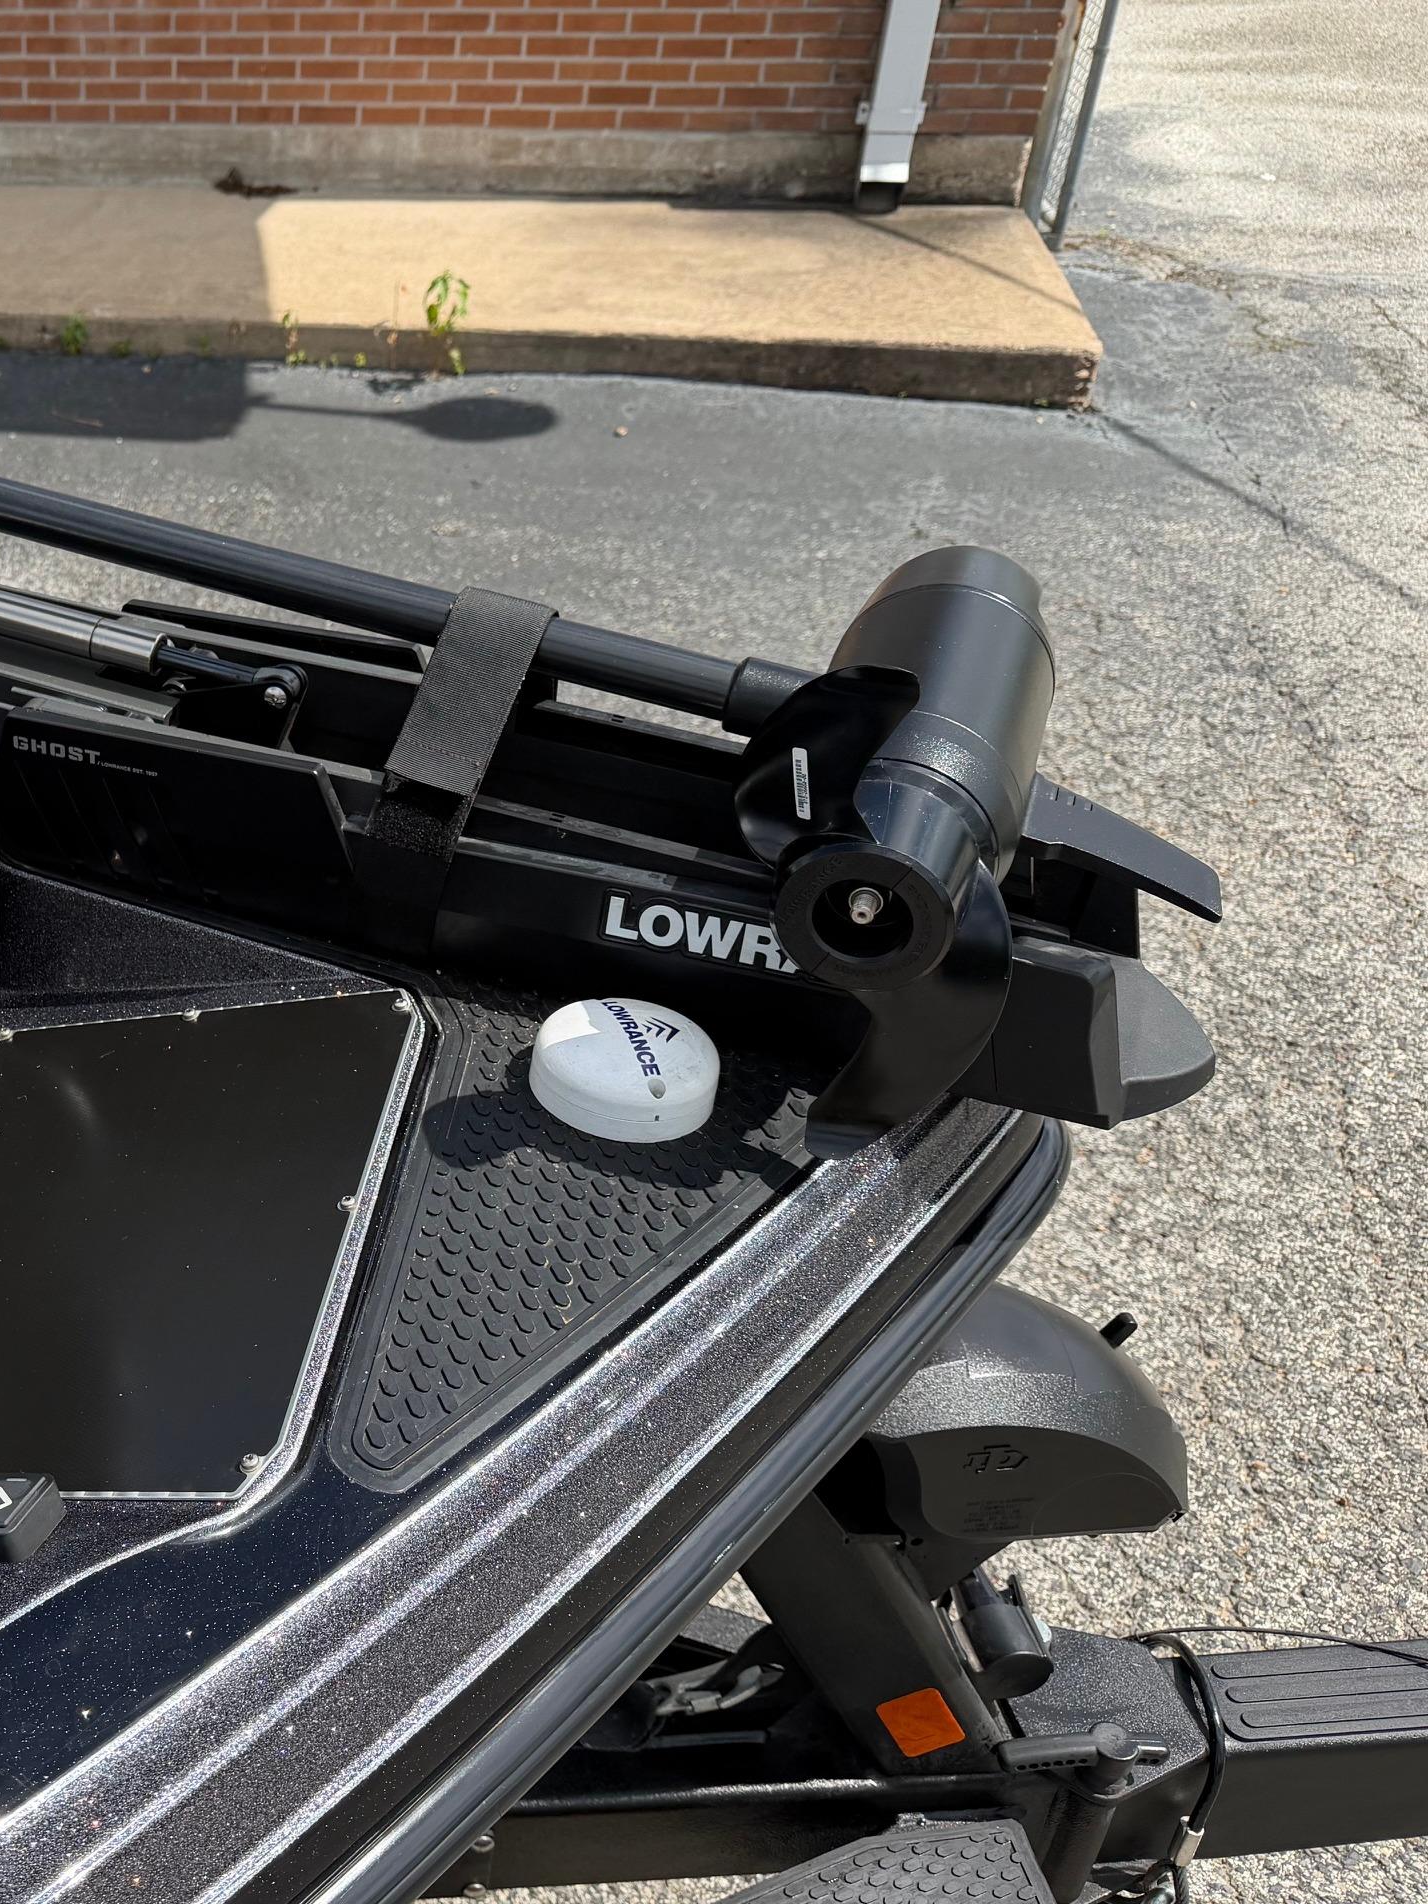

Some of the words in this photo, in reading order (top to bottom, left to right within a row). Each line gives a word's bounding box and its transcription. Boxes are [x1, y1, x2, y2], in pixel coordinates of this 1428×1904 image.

[13, 735, 100, 765] GHOST
[605, 896, 799, 974] LOWR
[601, 1001, 661, 1077] LOWRANCE
